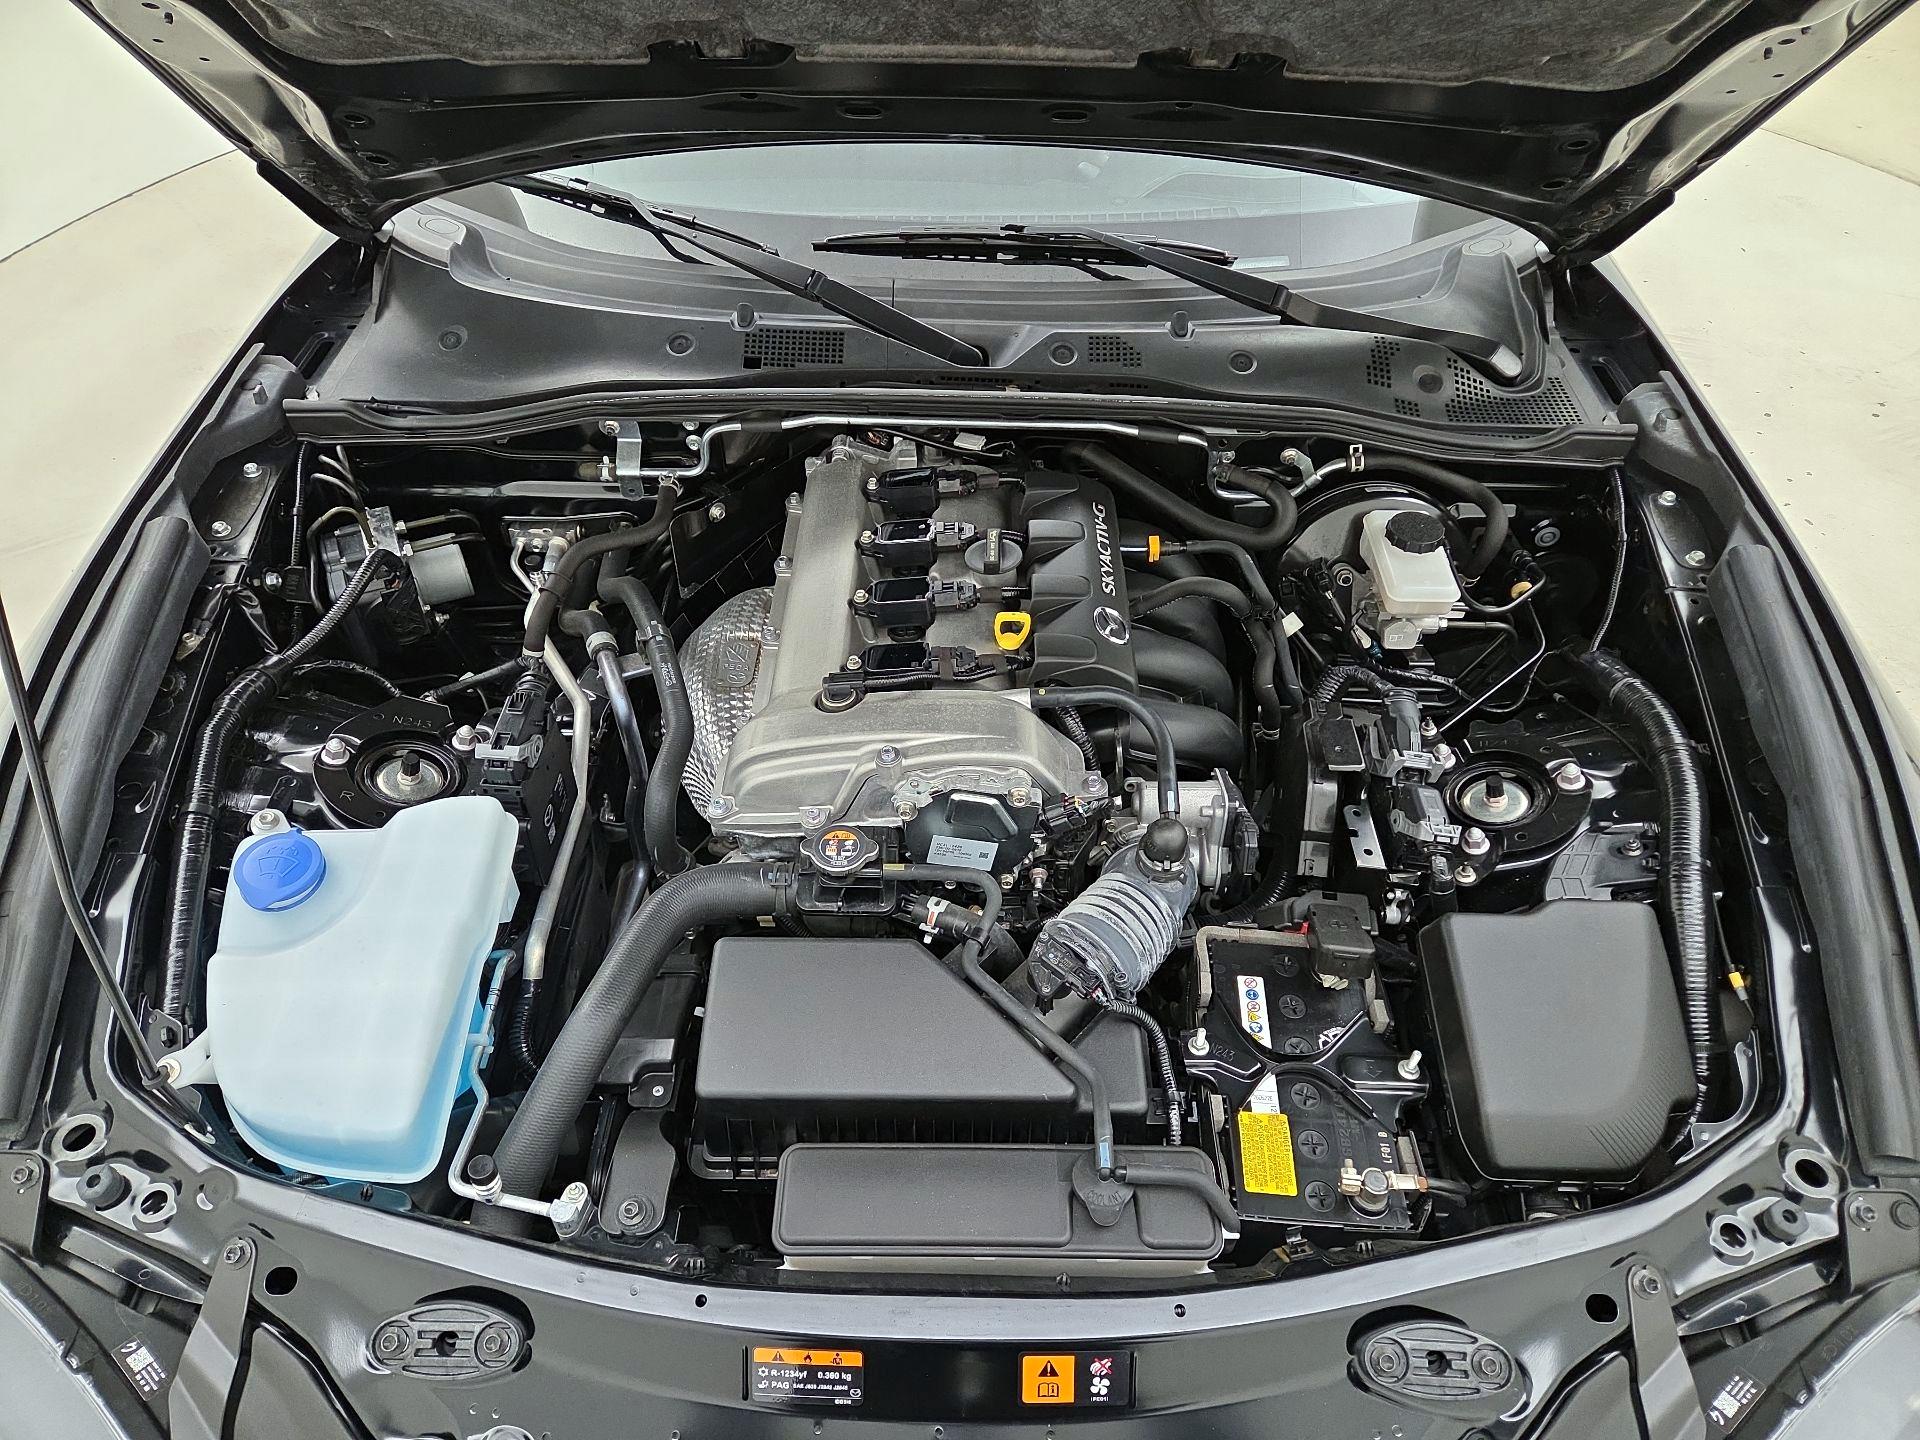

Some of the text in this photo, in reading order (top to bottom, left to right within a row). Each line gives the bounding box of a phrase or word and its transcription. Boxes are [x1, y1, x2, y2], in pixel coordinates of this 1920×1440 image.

[1092, 501, 1116, 597] SKYACTIV-G
[1209, 1041, 1236, 1062] N243
[1281, 1127, 1291, 1152] DANGER
[1083, 1190, 1123, 1207] COOLANT
[770, 1369, 808, 1380] R-1234yf
[841, 1371, 852, 1381] kg
[771, 1381, 790, 1390] PAG
